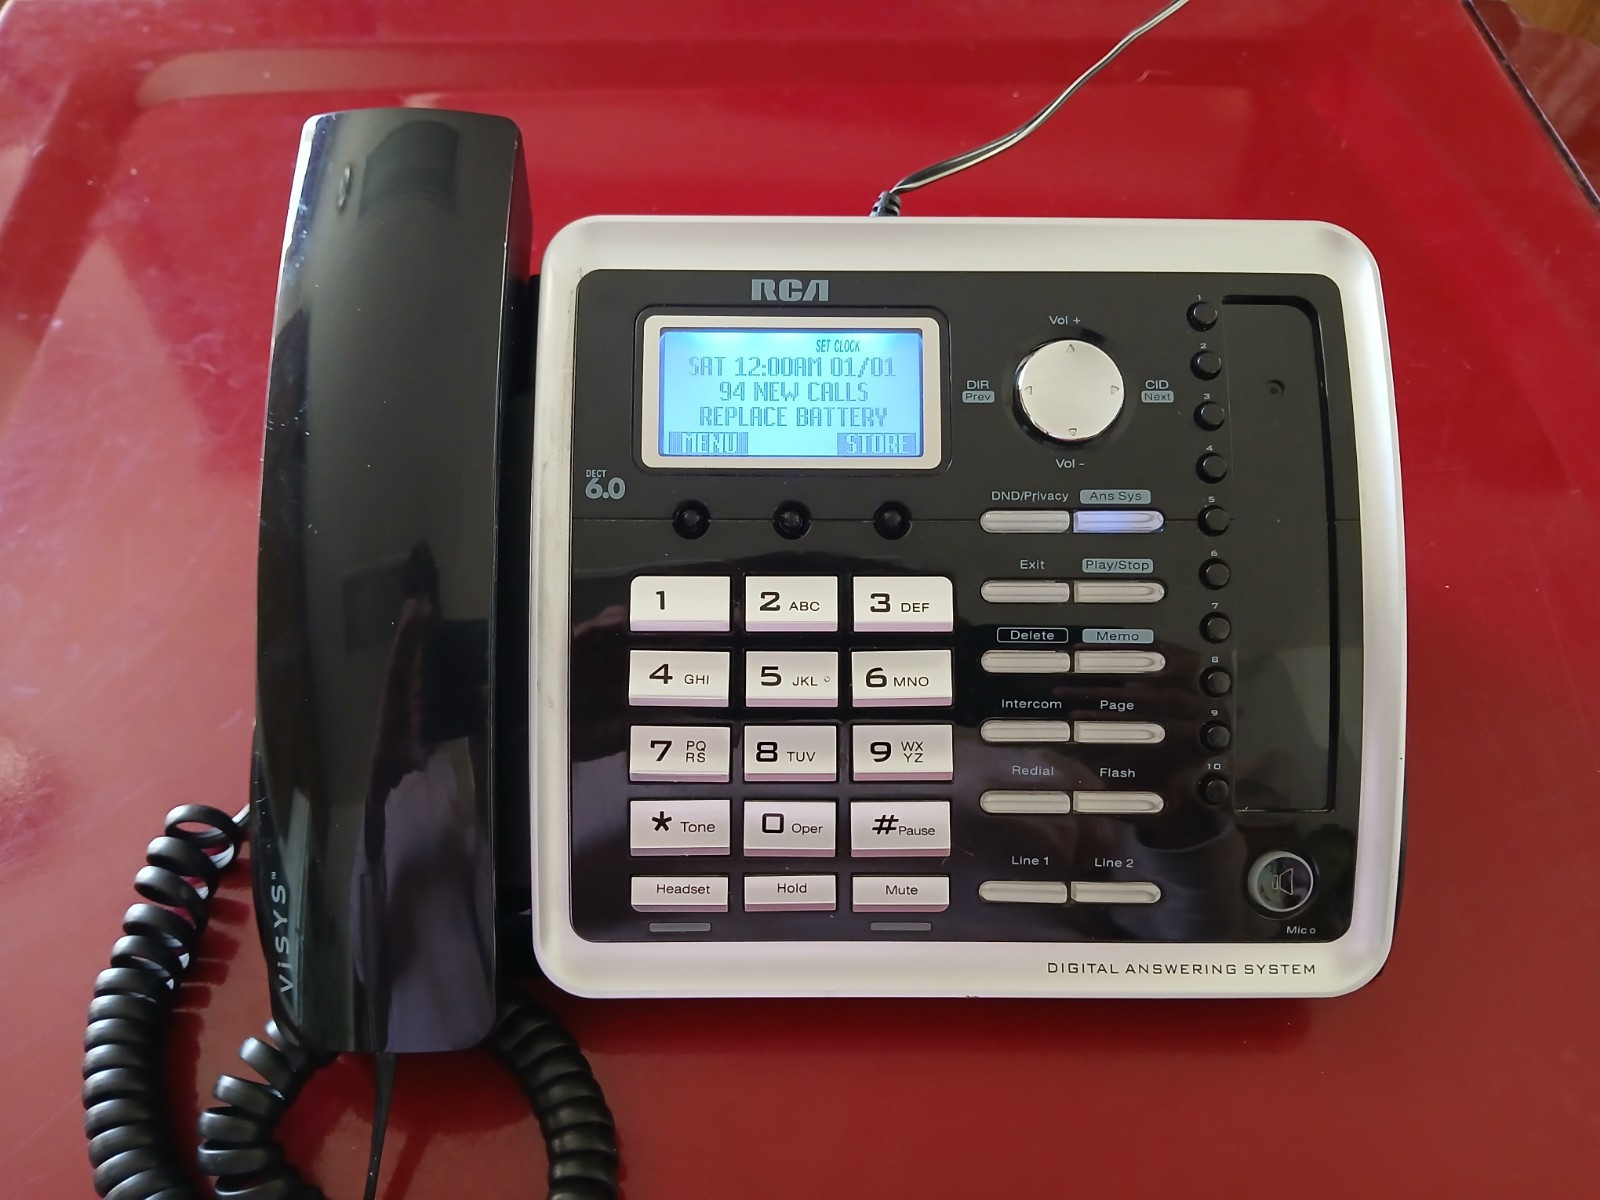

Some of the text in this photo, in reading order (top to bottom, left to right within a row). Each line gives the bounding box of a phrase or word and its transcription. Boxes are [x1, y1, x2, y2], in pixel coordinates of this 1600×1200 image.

[751, 279, 829, 301] RCA
[1049, 315, 1068, 325] Vol
[816, 340, 860, 352] SET CLOCK
[689, 356, 896, 378] SAT 12:00AM 01/01
[967, 380, 989, 389] DIR
[1145, 380, 1169, 389] CID
[719, 382, 868, 401] 94 NEW CALLS
[965, 392, 991, 401] Prev
[1144, 392, 1171, 401] Next
[700, 407, 887, 426] REPLACE BATTERY
[681, 433, 738, 454] MENU
[846, 433, 909, 454] STORE
[1055, 458, 1075, 468] Vol
[585, 477, 625, 499] 6.0
[991, 491, 1069, 503] DND/Privacy
[1090, 491, 1142, 503] Ans Sys
[1020, 560, 1044, 569] Exit
[1086, 560, 1149, 572] Play/Stop
[656, 591, 665, 610] 1
[760, 592, 820, 611] 2 ABC
[870, 593, 930, 613] 3 DEF
[1011, 630, 1054, 640] Delete
[1097, 632, 1139, 641] Memo
[649, 664, 709, 685] 4 GHI
[761, 666, 818, 686] 5 JKL
[865, 668, 929, 687] 6 MNO
[1001, 699, 1062, 709] Intercom
[1100, 701, 1134, 712] Page
[650, 741, 706, 761] 7 PQ
[756, 741, 816, 762] 8 TUV
[870, 741, 923, 762] 9 WX
[686, 752, 705, 763] RS
[903, 753, 923, 763] YZ
[1012, 766, 1054, 775] Redial
[1100, 768, 1135, 778] Flash
[681, 822, 715, 833] Tone
[762, 813, 823, 835] 0 Oper
[872, 815, 936, 836] # Pause
[1012, 856, 1049, 866] Line 1
[1094, 858, 1133, 868] Line 2
[656, 884, 710, 894] Headset
[777, 883, 807, 893] Hold
[886, 885, 918, 895] Mute
[1048, 962, 1316, 975] DIGITAL ANSWERING SYSTEM
